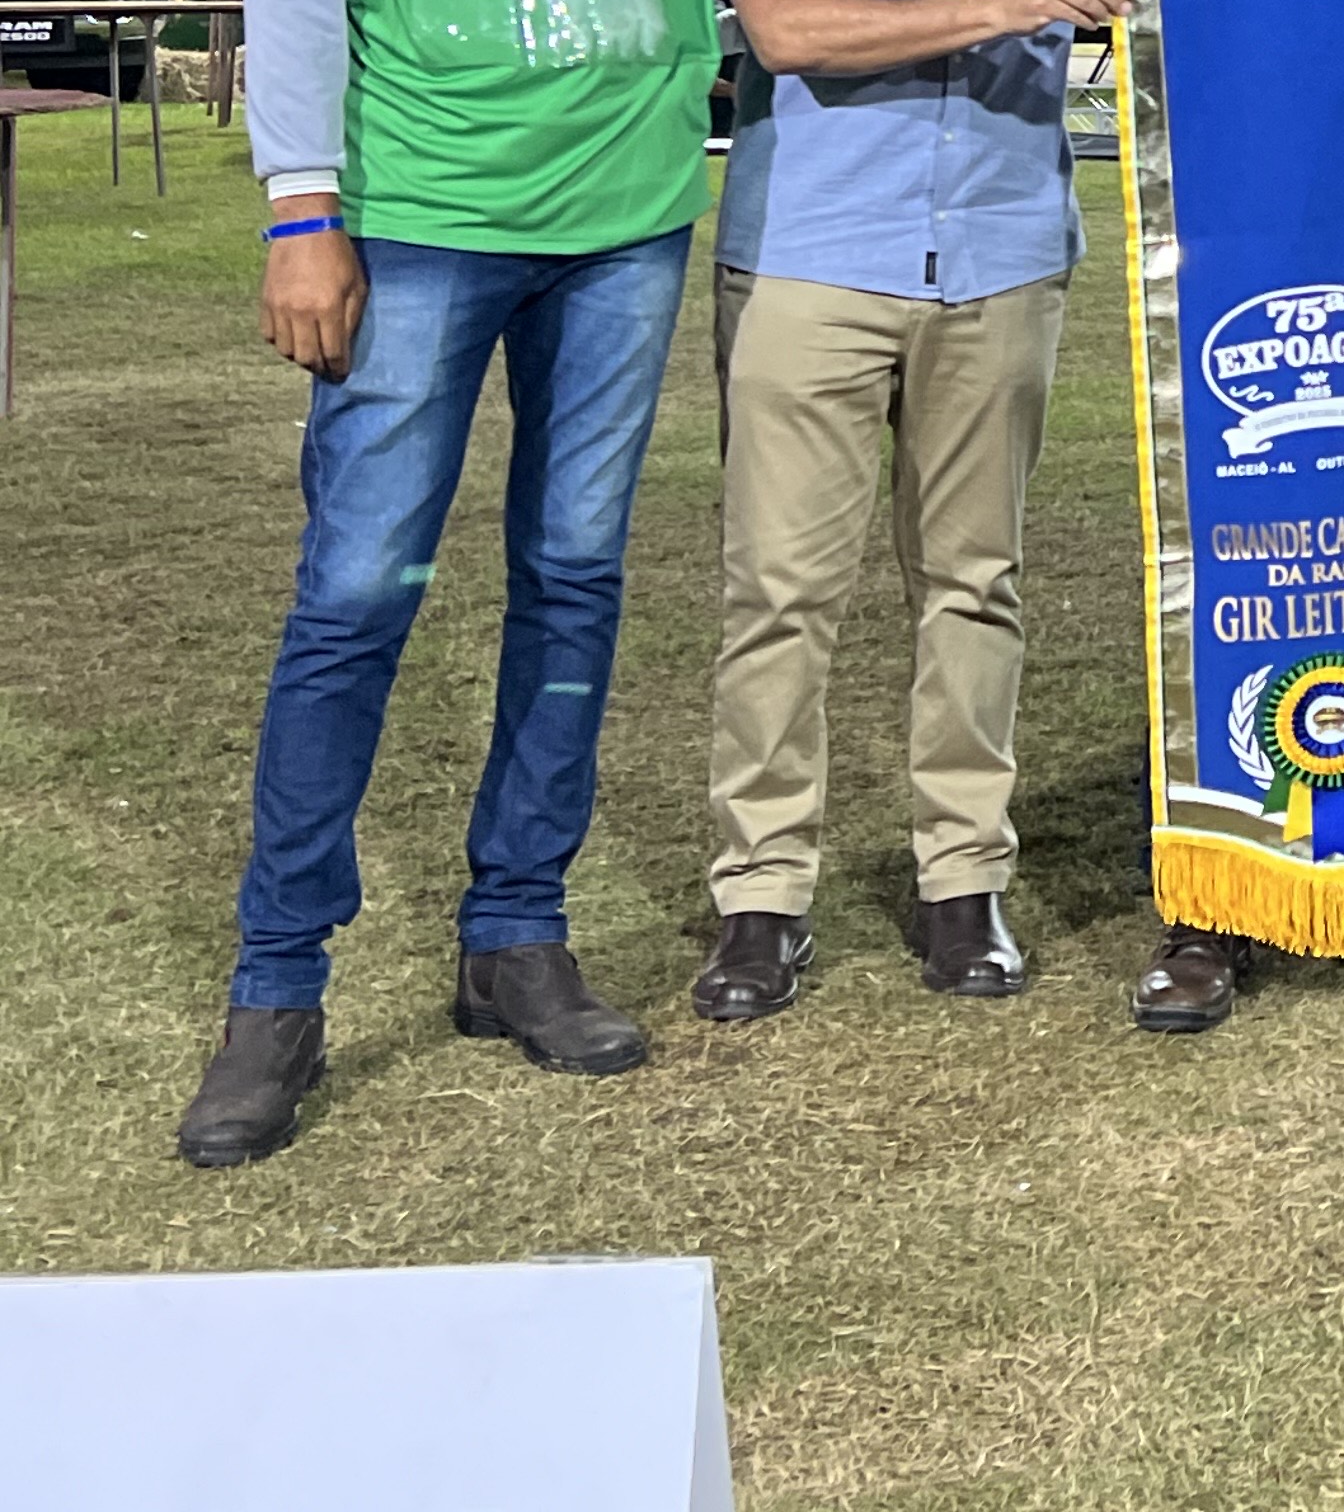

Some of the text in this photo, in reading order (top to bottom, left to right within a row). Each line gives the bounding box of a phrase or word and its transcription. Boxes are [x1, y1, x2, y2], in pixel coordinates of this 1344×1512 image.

[1211, 520, 1314, 561] GRANDE
[1267, 563, 1307, 587] DA
[1212, 595, 1281, 644] GIR
